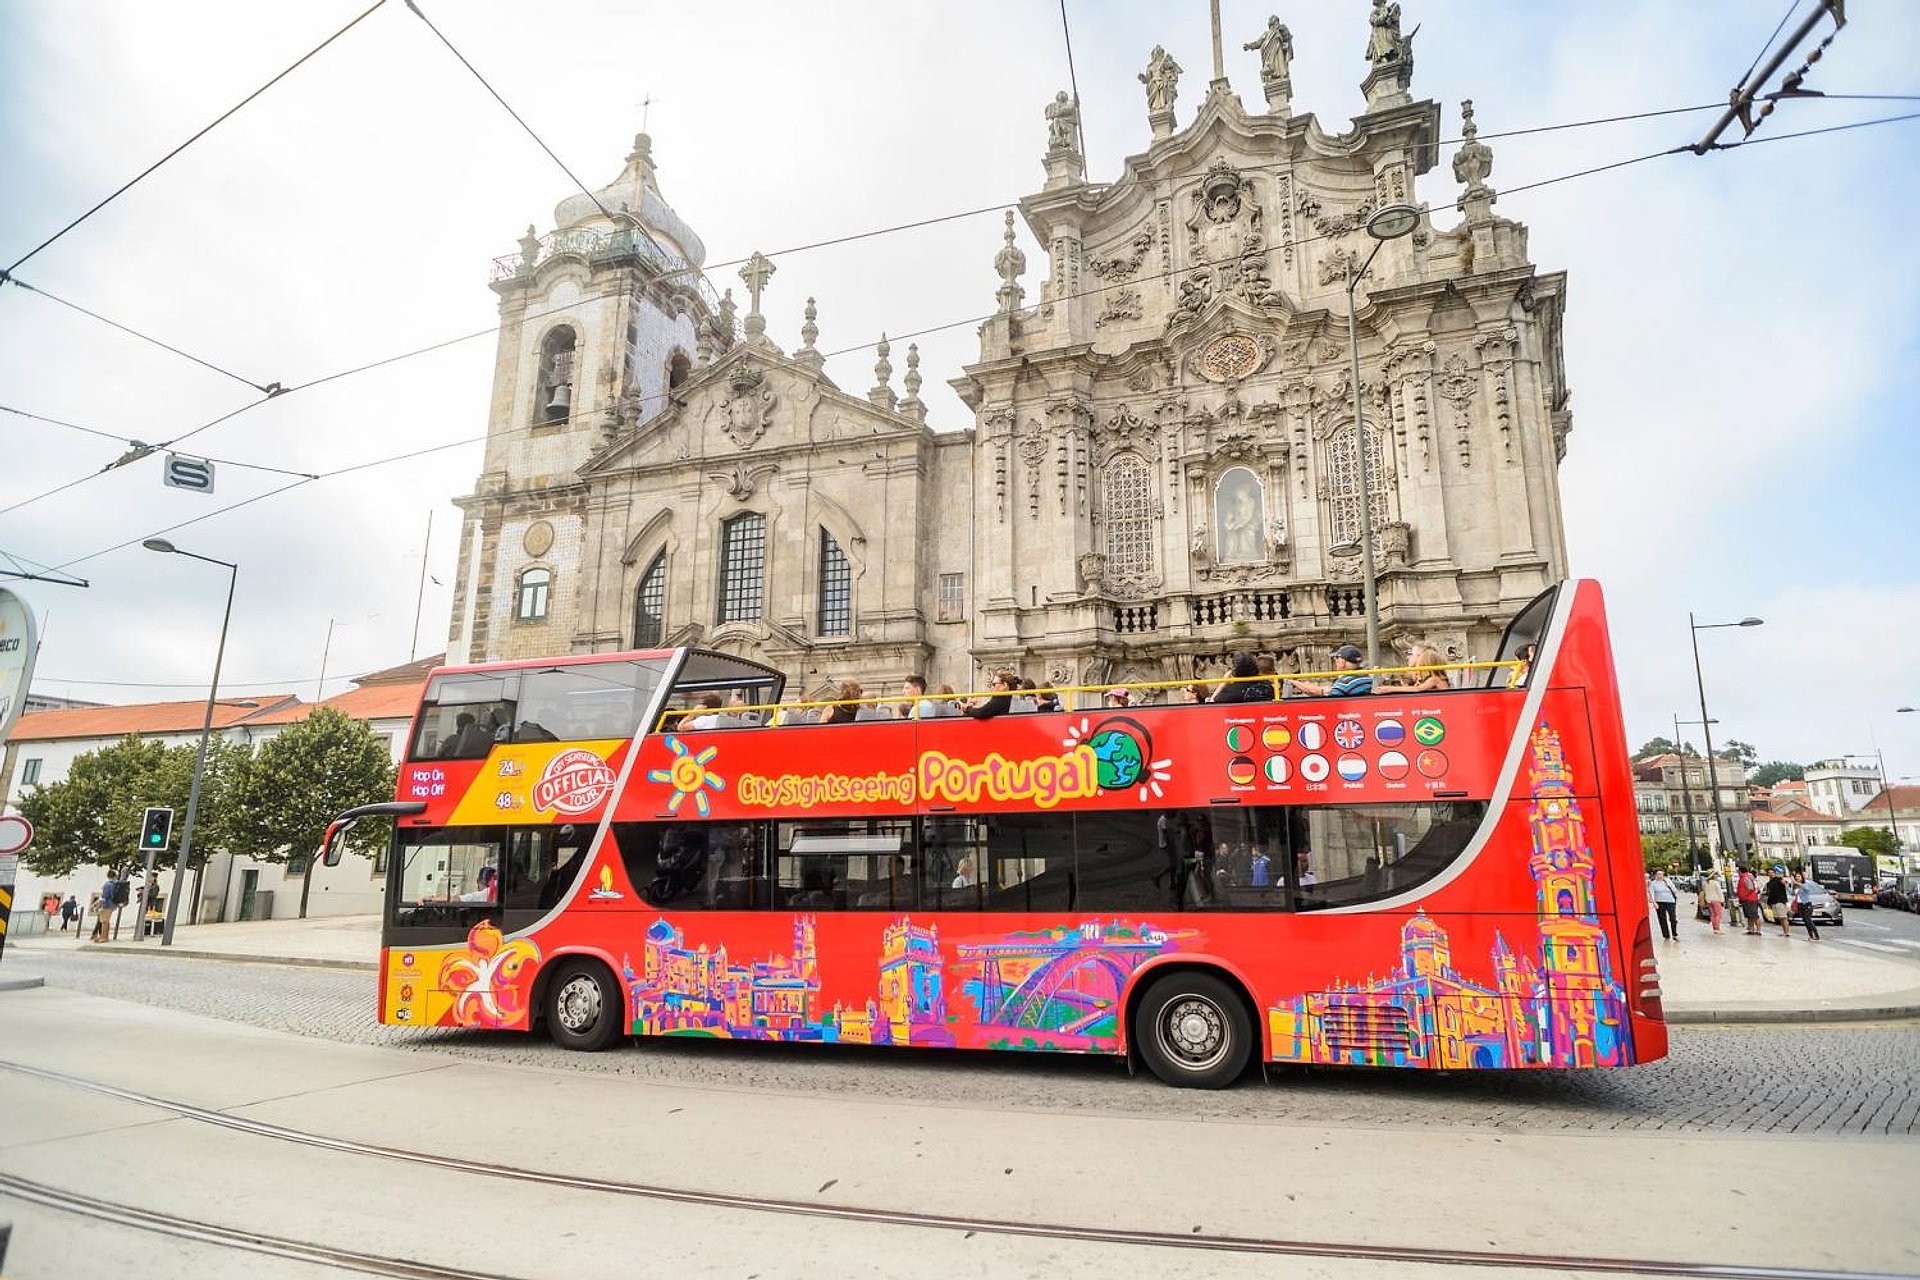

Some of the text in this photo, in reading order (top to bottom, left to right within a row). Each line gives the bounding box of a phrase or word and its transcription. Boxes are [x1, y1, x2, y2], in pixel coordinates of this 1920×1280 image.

[413, 769, 445, 782] Hop On
[499, 760, 515, 776] 24
[919, 745, 1097, 808] Portugal
[411, 783, 446, 798] Hop Off
[541, 768, 613, 801] OFFICIAL
[496, 791, 512, 808] 48
[569, 788, 599, 806] TOUR
